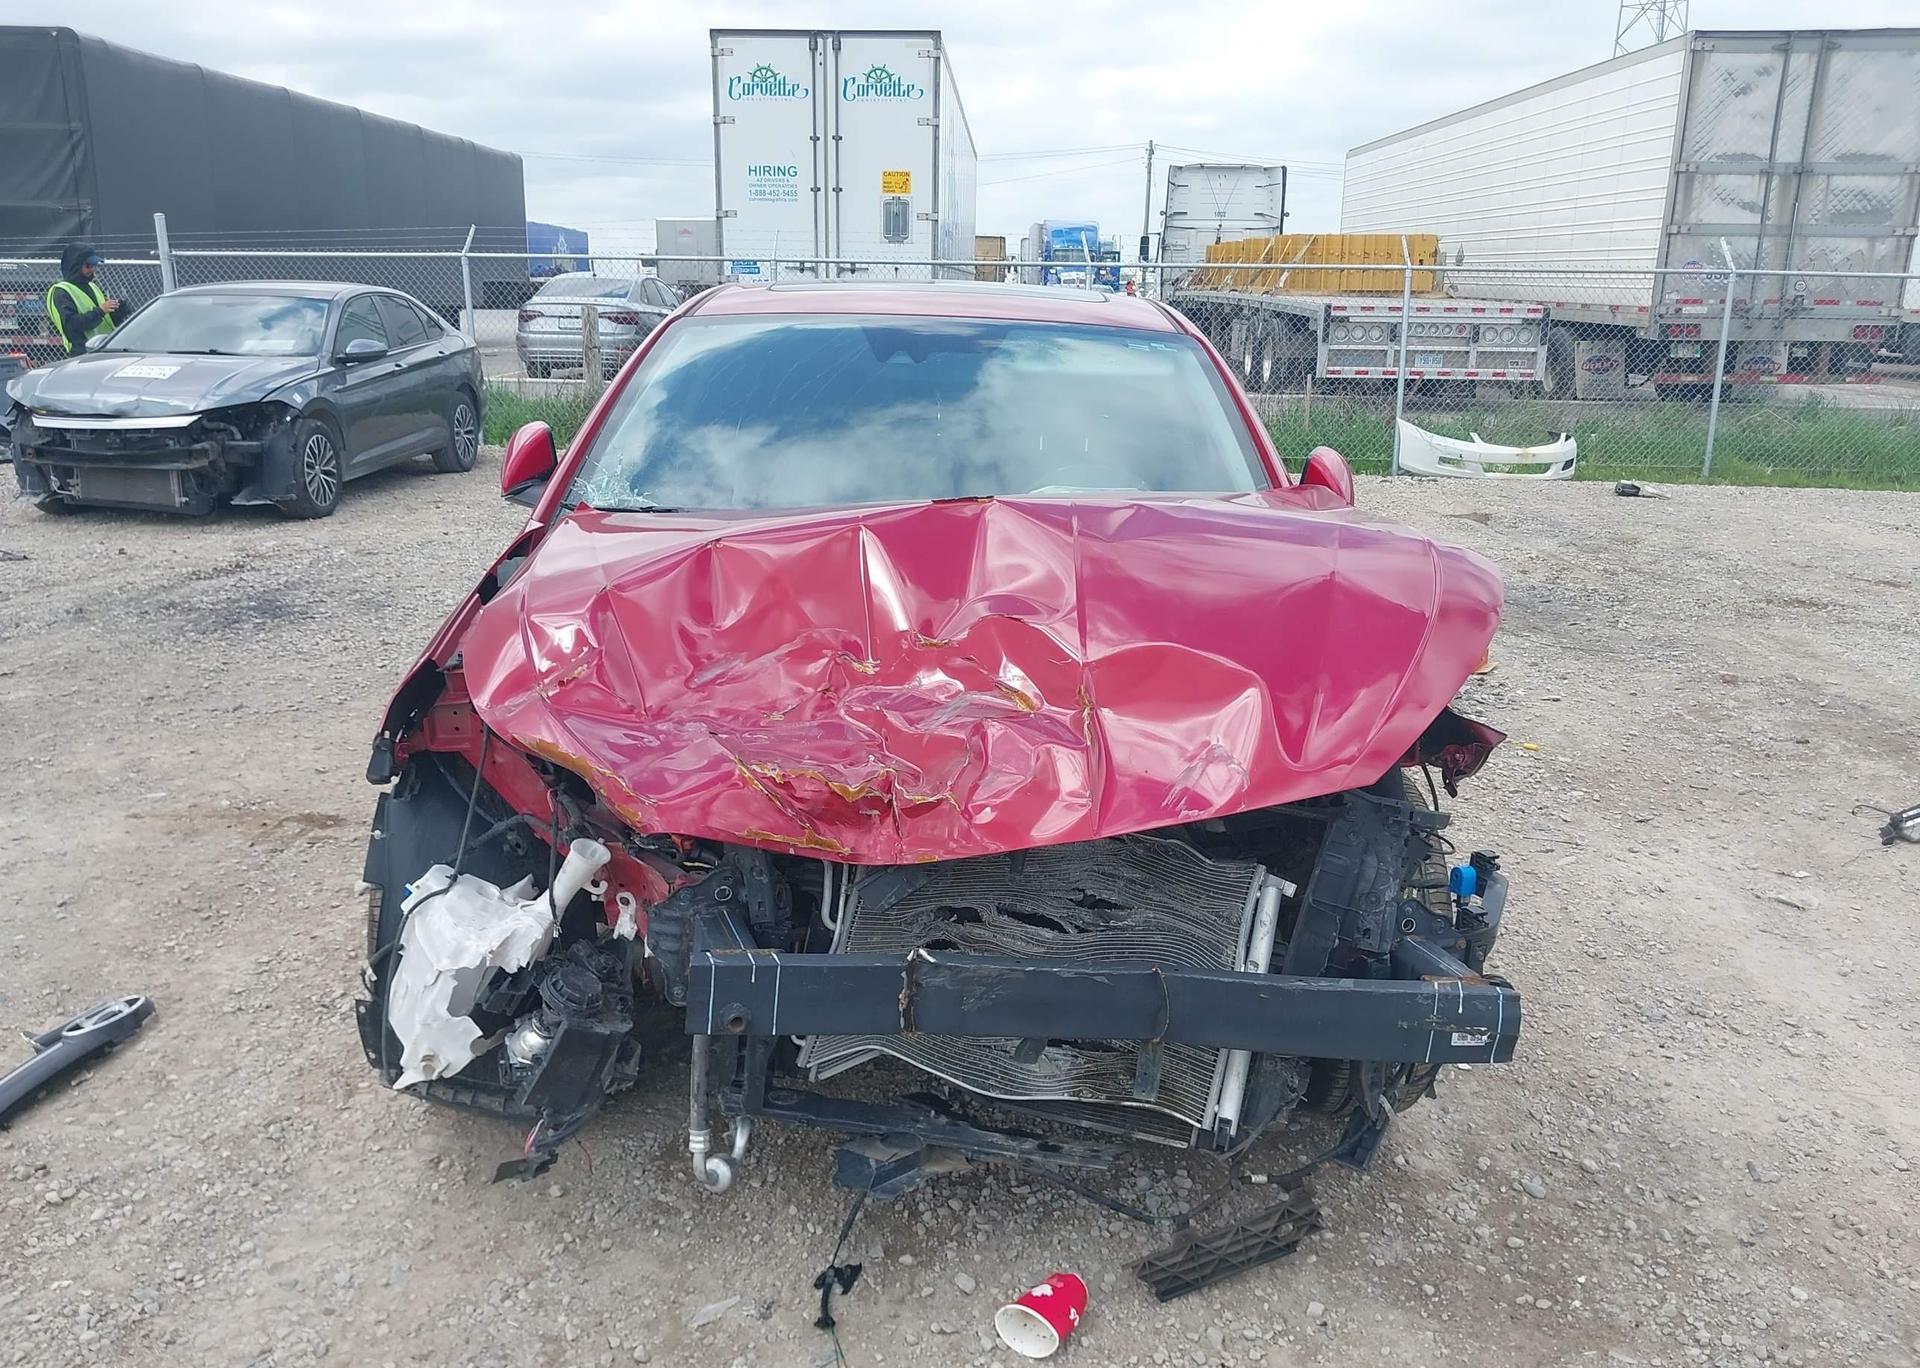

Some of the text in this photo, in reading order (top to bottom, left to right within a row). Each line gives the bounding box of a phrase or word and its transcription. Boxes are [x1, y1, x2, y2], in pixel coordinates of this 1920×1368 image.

[728, 75, 809, 101] Corvette
[843, 75, 924, 102] Corvette
[748, 165, 798, 177] HIRING
[749, 189, 798, 197] 1-888-452-5455
